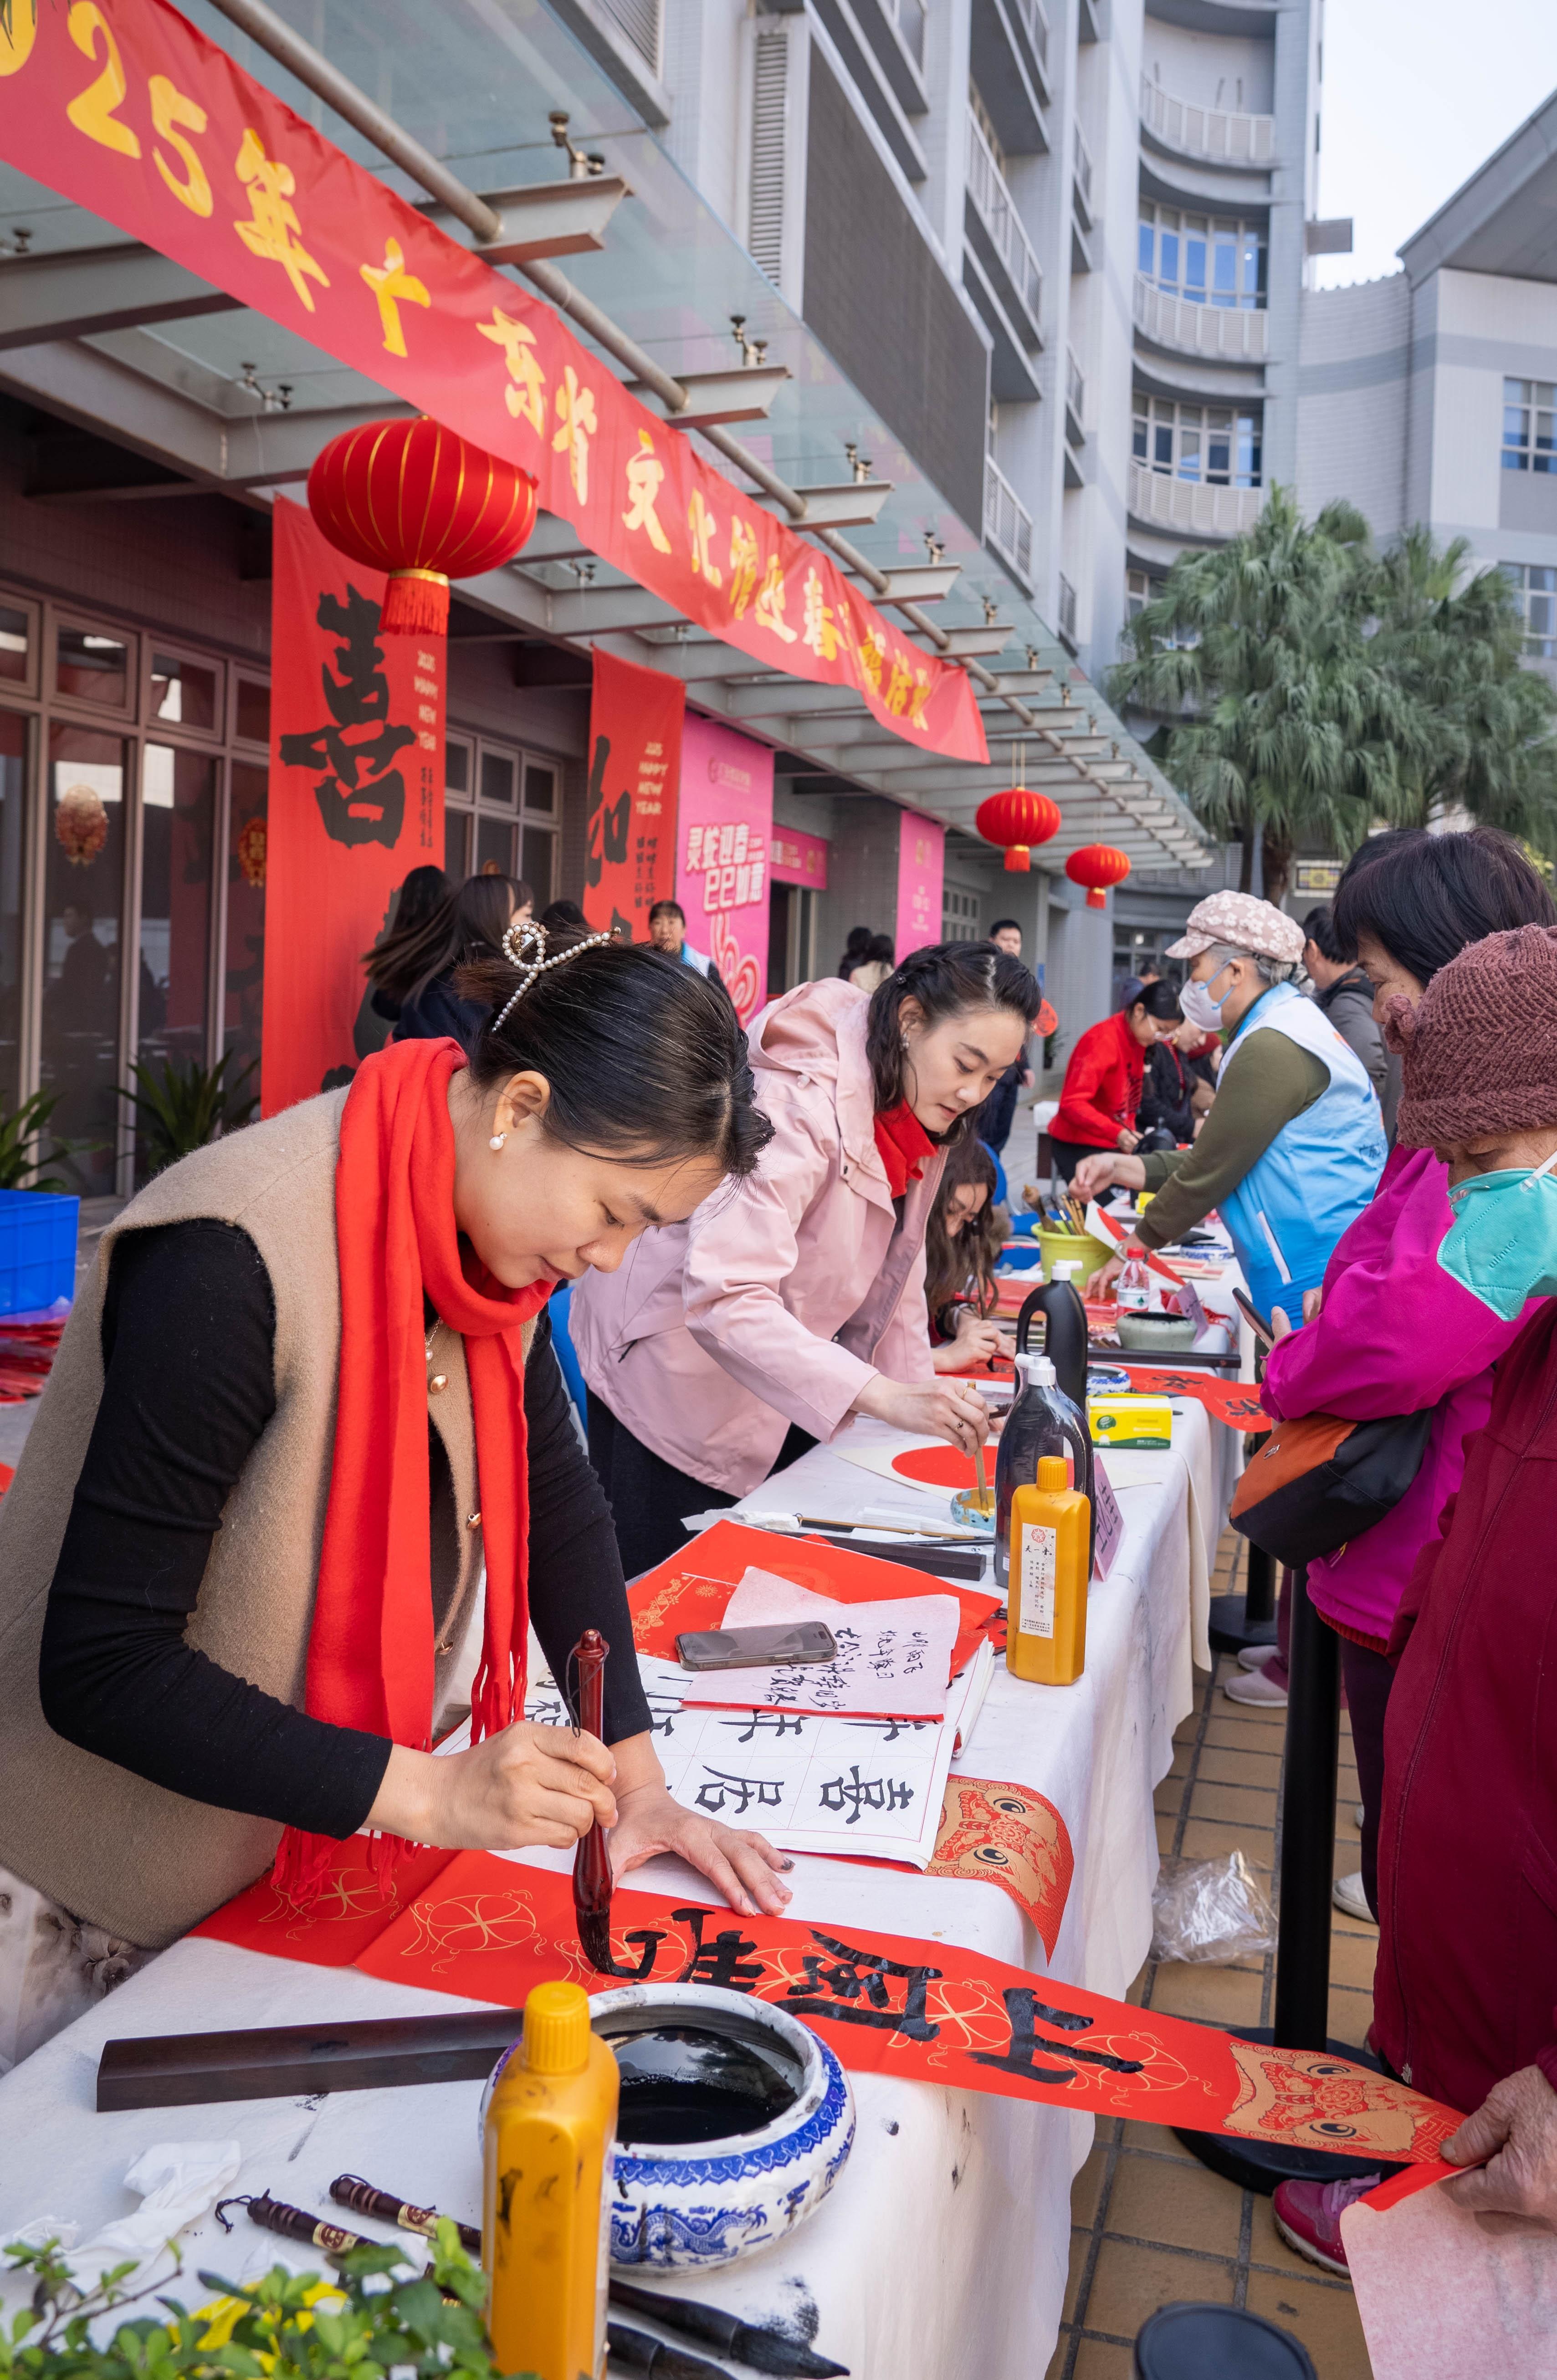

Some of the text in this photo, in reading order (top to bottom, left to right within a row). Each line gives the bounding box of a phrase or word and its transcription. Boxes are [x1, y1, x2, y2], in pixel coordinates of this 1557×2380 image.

[638, 761, 670, 777] HAPPY
[637, 781, 664, 797] NEW
[635, 800, 662, 816] YEAR
[1489, 1235, 1518, 1269] winner
